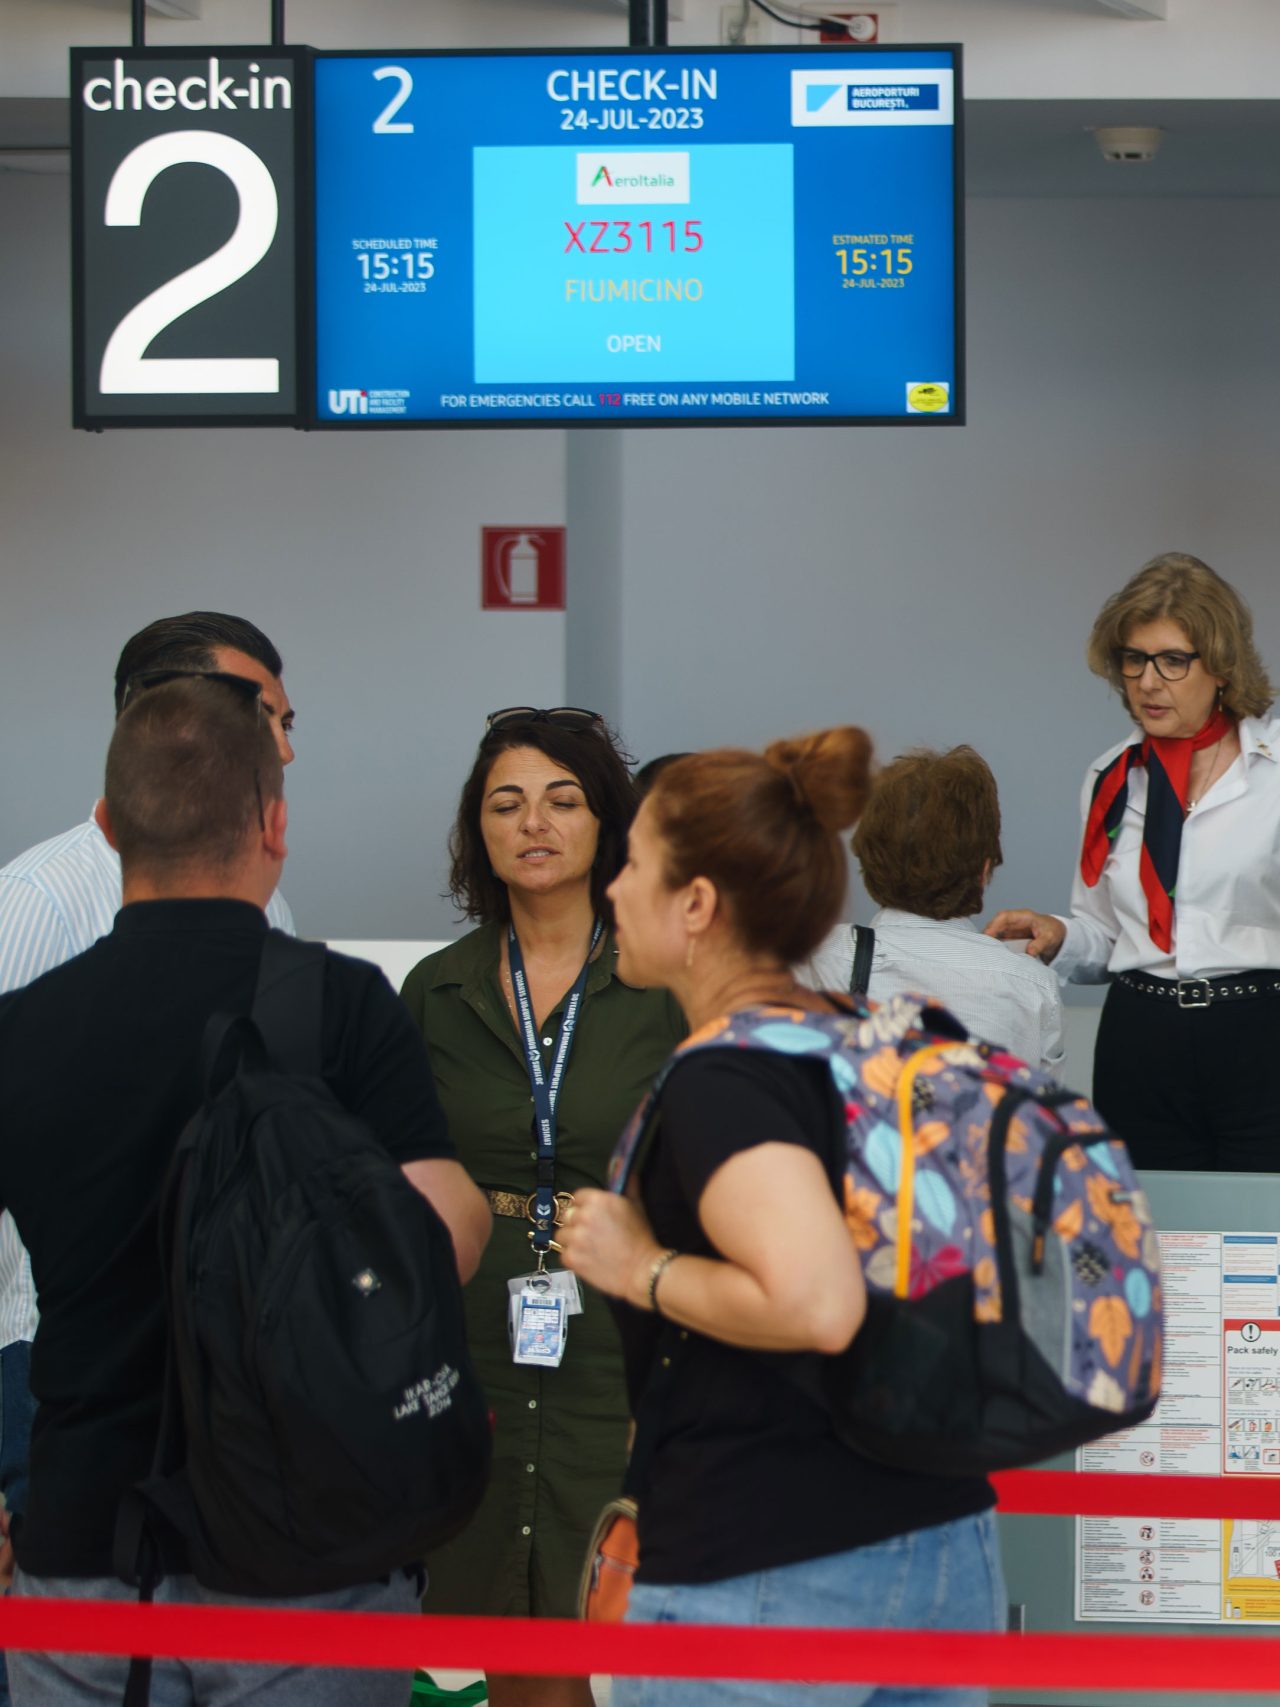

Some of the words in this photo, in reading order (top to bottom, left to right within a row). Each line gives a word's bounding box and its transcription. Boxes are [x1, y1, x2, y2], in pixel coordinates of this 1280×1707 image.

[83, 57, 291, 111] check-in
[546, 69, 717, 101] CHECK-IN
[852, 87, 920, 97] AEROPORTURI
[372, 66, 414, 134] 2
[560, 108, 704, 131] 24-JUL-2023
[591, 165, 675, 188] AeroItalia
[352, 238, 411, 250] SCHEDULED
[413, 238, 438, 249] TIME
[564, 220, 704, 254] XZ3115
[832, 234, 888, 246] ESTIMATED
[890, 233, 914, 245] TIME
[100, 130, 279, 394] 2
[356, 253, 435, 280] 15:15
[835, 248, 913, 275] 15:15
[364, 282, 427, 293] 24-JUL-2023
[565, 279, 703, 302] FIUMICINO
[842, 278, 905, 289] 24-JUL-2023
[606, 335, 662, 353] OPEN
[441, 394, 467, 407] FOR
[469, 394, 561, 407] EMERGENCIES
[563, 394, 596, 407] CALL
[599, 393, 621, 406] 112
[624, 393, 655, 406] FREE
[658, 393, 679, 405] ON
[681, 392, 708, 405] ANY
[711, 392, 760, 405] MOBILE
[764, 392, 829, 405] NETWORK
[1227, 1346, 1248, 1354] Pack
[1251, 1346, 1278, 1356] safely
